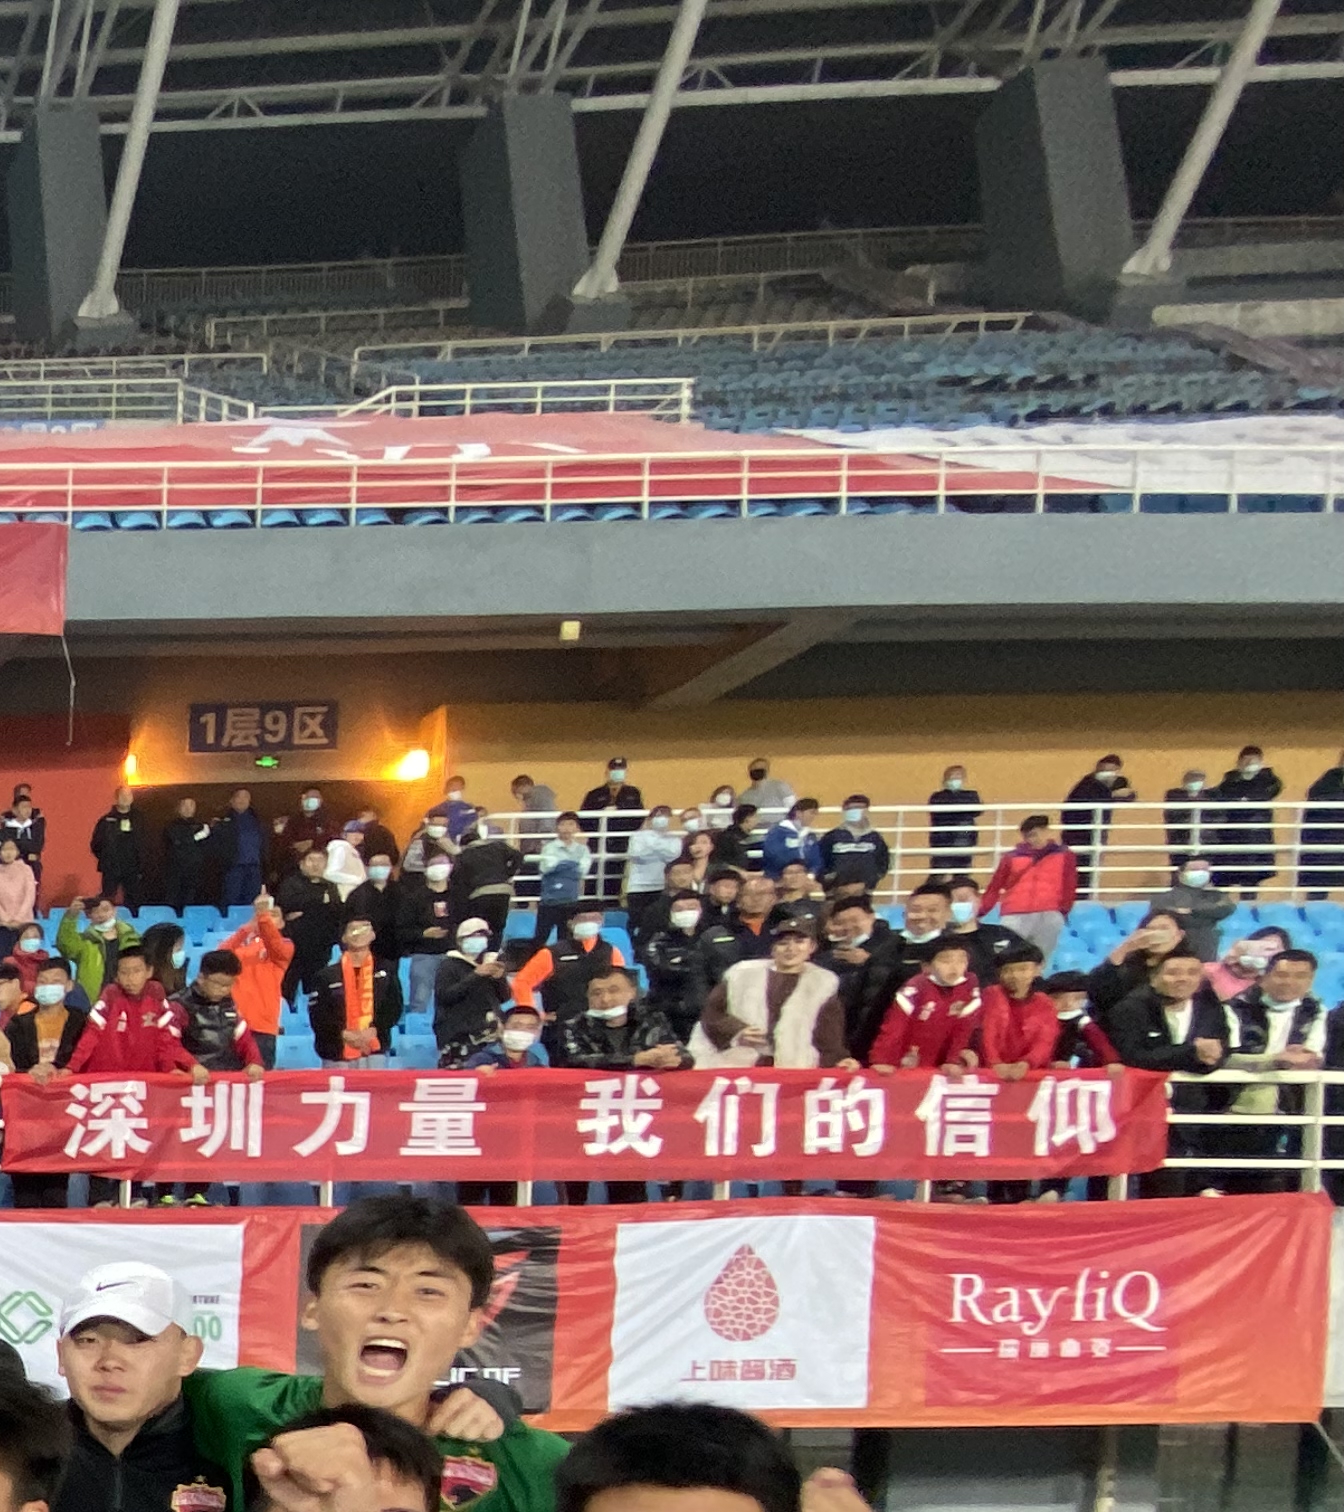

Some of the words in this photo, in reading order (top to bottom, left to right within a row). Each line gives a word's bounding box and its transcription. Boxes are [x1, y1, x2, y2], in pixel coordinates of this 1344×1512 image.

[199, 704, 330, 747] 1层9区
[64, 1077, 488, 1160] 深圳力量
[576, 1074, 1119, 1158] 我们的信仰
